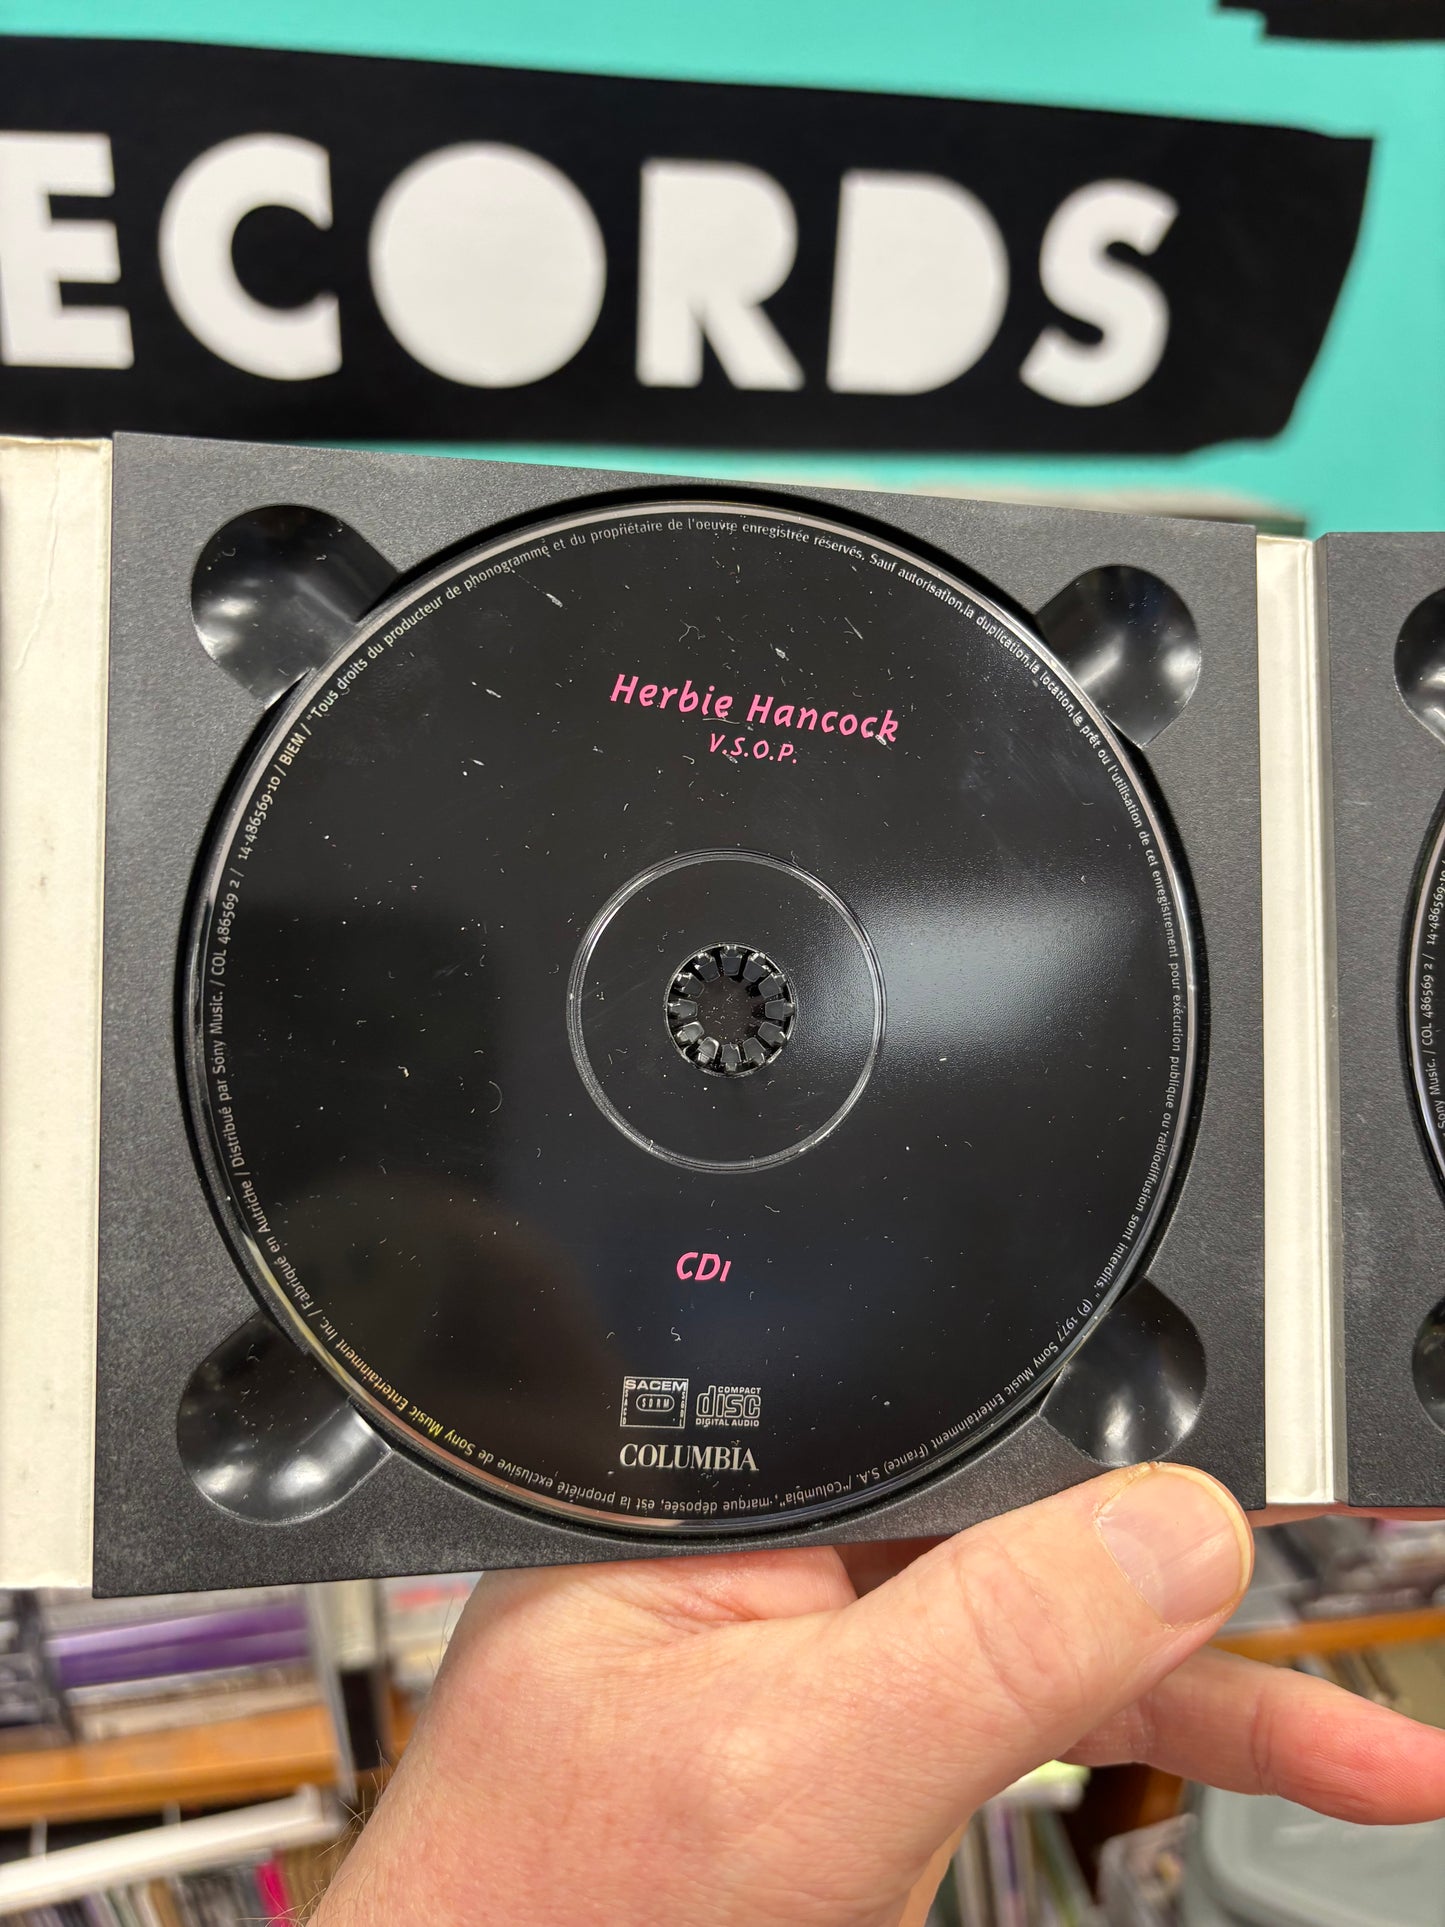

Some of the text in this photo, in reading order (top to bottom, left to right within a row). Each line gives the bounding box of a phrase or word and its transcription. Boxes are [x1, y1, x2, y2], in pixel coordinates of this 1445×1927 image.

[568, 531, 586, 547] du
[588, 519, 664, 545] propriétaire
[666, 518, 683, 531] de
[688, 518, 738, 532] l'oeuvre
[741, 520, 811, 546] enregistrée
[551, 538, 567, 552] et
[812, 533, 868, 561] réservés.
[461, 542, 551, 593] phonogramme
[867, 551, 898, 574] Sauf
[442, 582, 463, 601] de
[381, 593, 447, 648] producteur
[364, 640, 385, 661] du
[334, 655, 369, 691] droits
[610, 673, 899, 743] Herbie Hancock
[278, 730, 308, 767] BIEM
[709, 732, 798, 764] V.S.O.P.
[1078, 722, 1104, 751] prêt
[1095, 747, 1112, 766] ou
[1106, 762, 1146, 829] l'utilisation
[1137, 828, 1154, 847] de
[1144, 846, 1161, 867] cet
[229, 878, 241, 889] 2
[215, 890, 240, 945] 486569
[1148, 867, 1181, 959] enregistrement
[211, 947, 227, 976] COL
[1167, 961, 1181, 991] pour
[1420, 974, 1434, 1019] 486569
[210, 989, 223, 1035] Music.
[1171, 993, 1184, 1052] exécution
[1421, 1022, 1433, 1046] COL
[211, 1038, 228, 1075] Sony
[217, 1077, 232, 1102] par
[1161, 1055, 1182, 1110] publique
[1425, 1058, 1441, 1096] Music.
[1159, 1111, 1172, 1129] ou
[219, 1105, 246, 1168] Distribué
[1133, 1130, 1170, 1214] radiodiffusion
[239, 1178, 272, 1236] Autriche
[1120, 1212, 1142, 1242] sont
[265, 1234, 281, 1254] en
[273, 1252, 317, 1310] Fabriqué
[1072, 1295, 1095, 1318] (P)
[314, 1315, 339, 1341] Inc.
[1052, 1313, 1079, 1343] 1977
[1028, 1338, 1061, 1371] Sony
[333, 1337, 410, 1411] Entertainment
[624, 1379, 688, 1392] SACEM
[1002, 1365, 1036, 1398] Music
[696, 1385, 761, 1419] disc
[718, 1386, 761, 1395] COMPACT
[406, 1404, 445, 1436] Music
[695, 1418, 760, 1427] DIGITAL AUDIO
[929, 1391, 1006, 1450] Entertainment
[442, 1426, 478, 1455] Sony
[475, 1447, 496, 1465] de
[619, 1443, 760, 1472] COLUMBIA
[879, 1439, 930, 1475] (France)
[494, 1456, 555, 1490] exclusive
[854, 1465, 881, 1485] S.A.
[555, 1477, 616, 1505] propriété
[618, 1494, 632, 1508] la
[635, 1496, 655, 1510] est
[721, 1492, 771, 1510] marque
